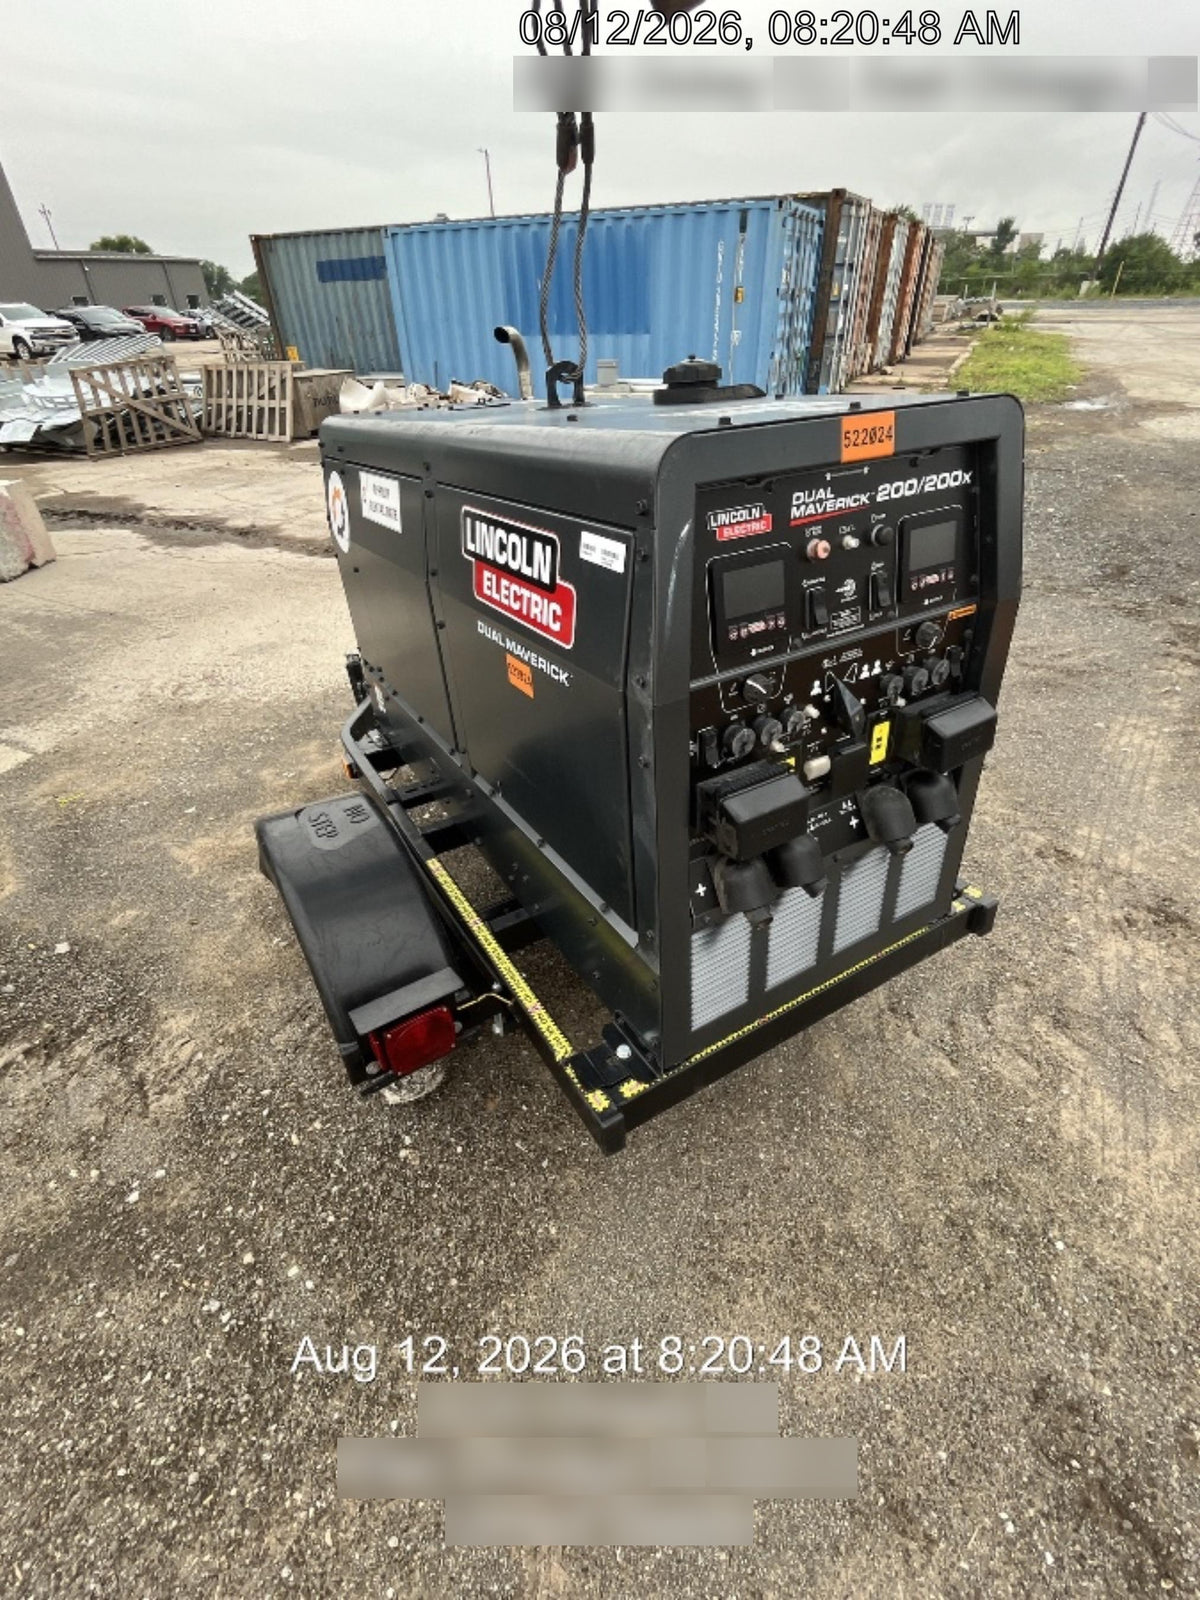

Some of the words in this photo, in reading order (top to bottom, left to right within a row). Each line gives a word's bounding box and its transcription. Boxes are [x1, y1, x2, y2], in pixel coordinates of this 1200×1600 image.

[843, 425, 893, 449] 522024
[790, 493, 870, 519] MAVERICK
[792, 486, 835, 506] DUAL
[709, 507, 760, 528] LINCOLN
[722, 521, 768, 538] ELECTRIC
[465, 517, 552, 585] LINCOLN
[482, 570, 563, 632] ELECTRIC
[477, 619, 506, 648] DUAL
[506, 637, 570, 688] MAVERICK
[307, 811, 340, 839] STEP
